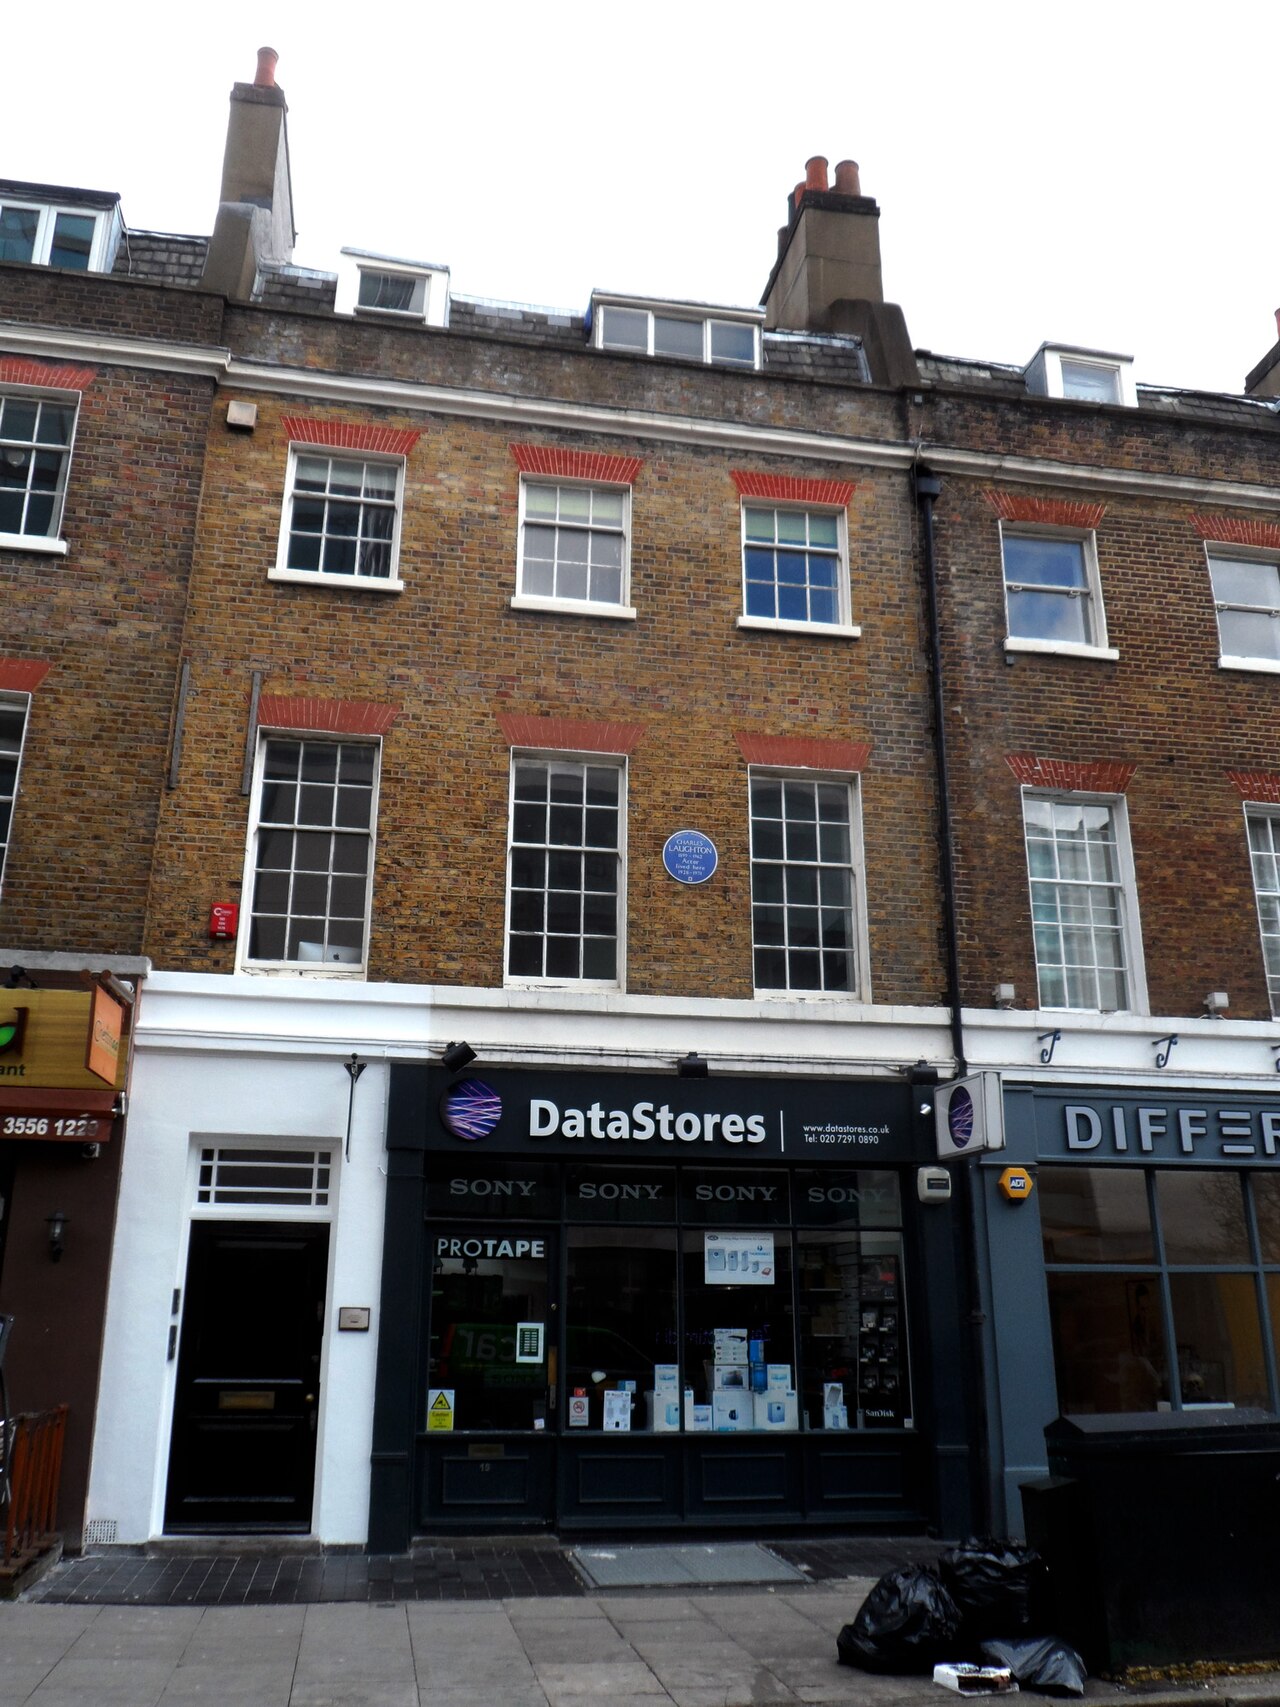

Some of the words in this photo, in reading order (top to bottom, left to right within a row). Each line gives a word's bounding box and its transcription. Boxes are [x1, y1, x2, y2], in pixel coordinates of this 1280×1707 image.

[668, 845, 712, 854] LAUGHTON
[3, 1117, 48, 1135] 3556
[529, 1099, 767, 1143] DataStores
[803, 1123, 890, 1134] www.datastores.co.uk
[804, 1134, 818, 1143] Tel:
[820, 1134, 836, 1143] 020
[837, 1135, 856, 1144] 7291
[858, 1135, 879, 1145] 0890
[450, 1179, 537, 1196] SONY
[578, 1183, 663, 1200] SONY
[1010, 1178, 1026, 1189] ADT
[695, 1185, 777, 1201] SONY
[807, 1187, 889, 1203] SONY
[437, 1238, 545, 1258] PROTAPE
[865, 1408, 896, 1418] SanDisk
